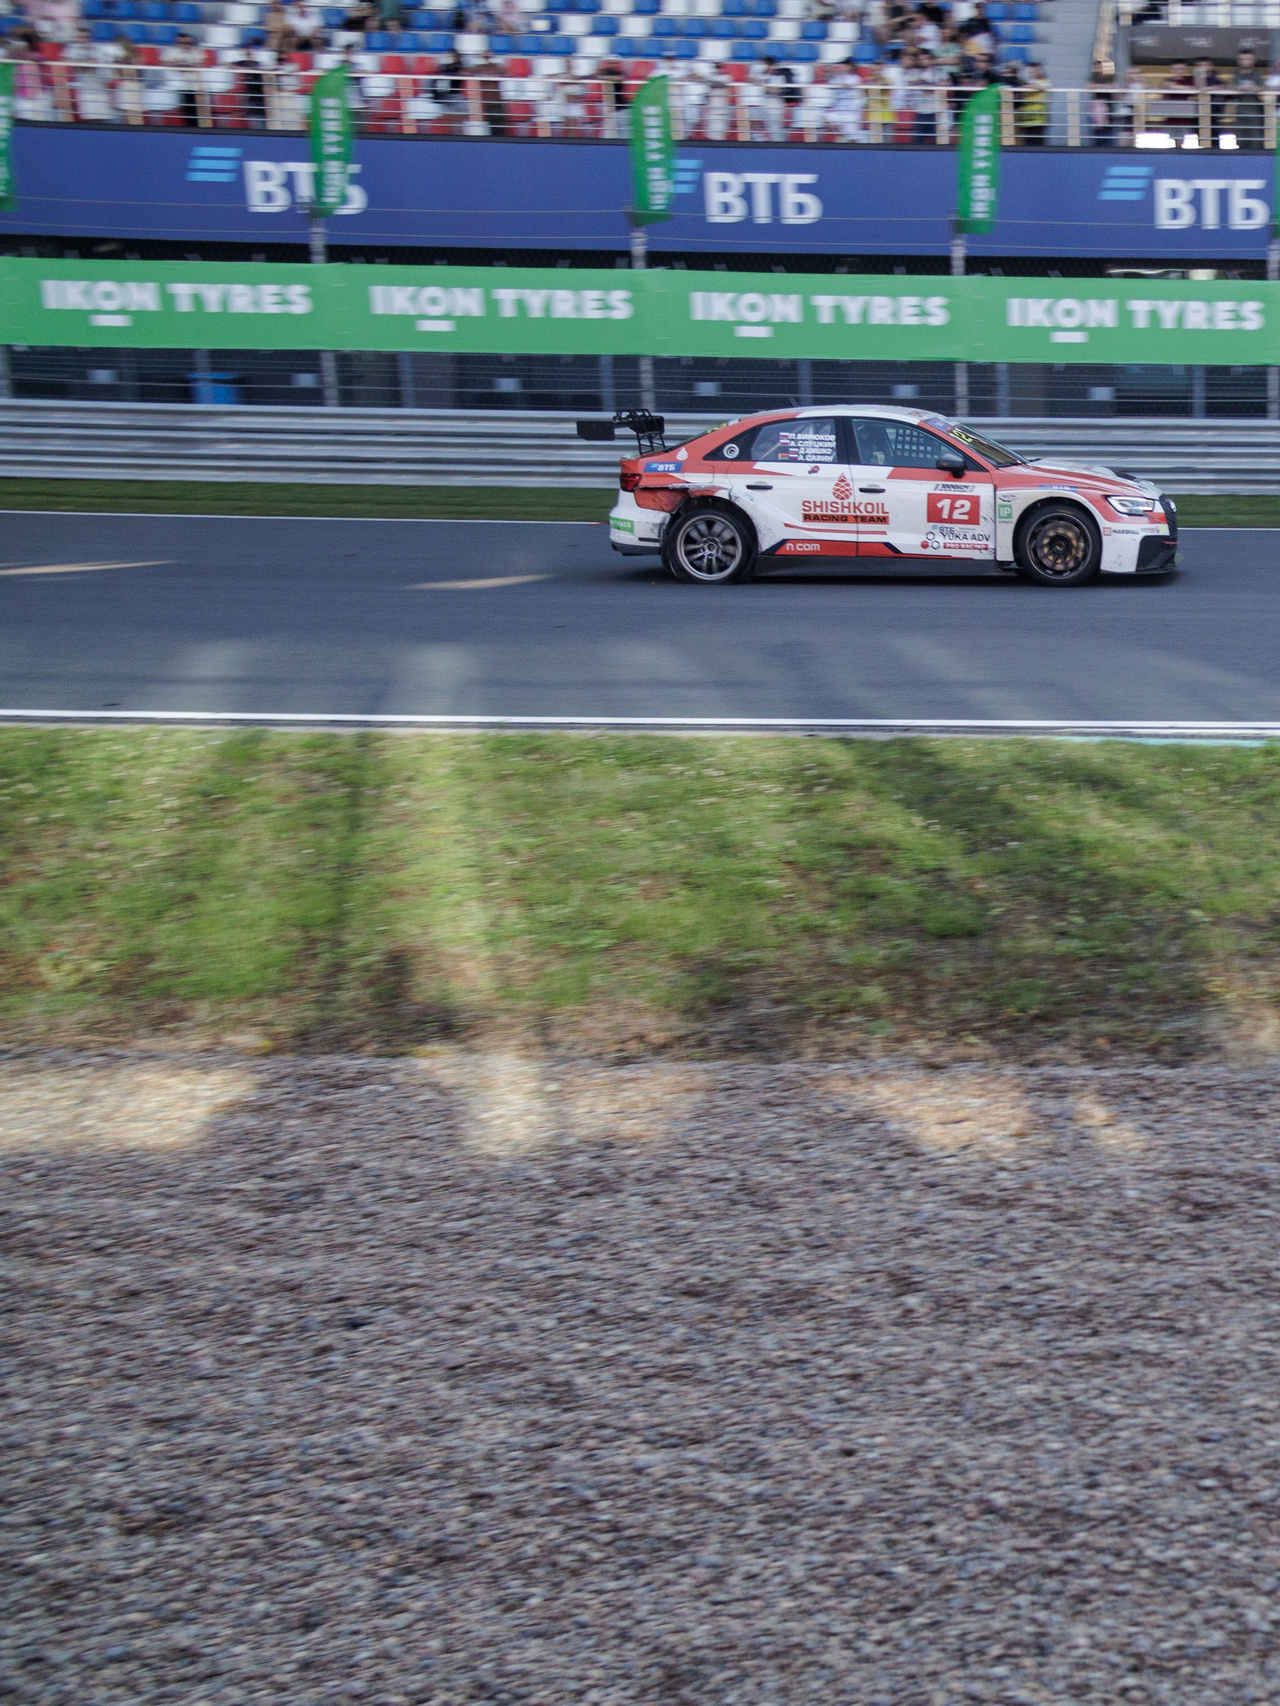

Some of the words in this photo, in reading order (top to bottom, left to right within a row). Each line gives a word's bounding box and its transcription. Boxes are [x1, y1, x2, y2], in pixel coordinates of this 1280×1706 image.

[703, 172, 823, 224] ВТБ
[1153, 178, 1270, 230] ВТБ
[41, 279, 162, 312] IKON
[168, 282, 314, 315] TYRES
[369, 284, 486, 317] IKON
[492, 288, 634, 320] TYRES
[689, 291, 803, 324] IKON
[810, 294, 950, 327] TYRES
[1006, 297, 1119, 329] IKON
[1127, 300, 1266, 331] TYRES
[802, 500, 889, 514] SHISHKOIL
[804, 514, 849, 523] RACING
[853, 515, 887, 523] TEAM
[936, 498, 971, 520] 12
